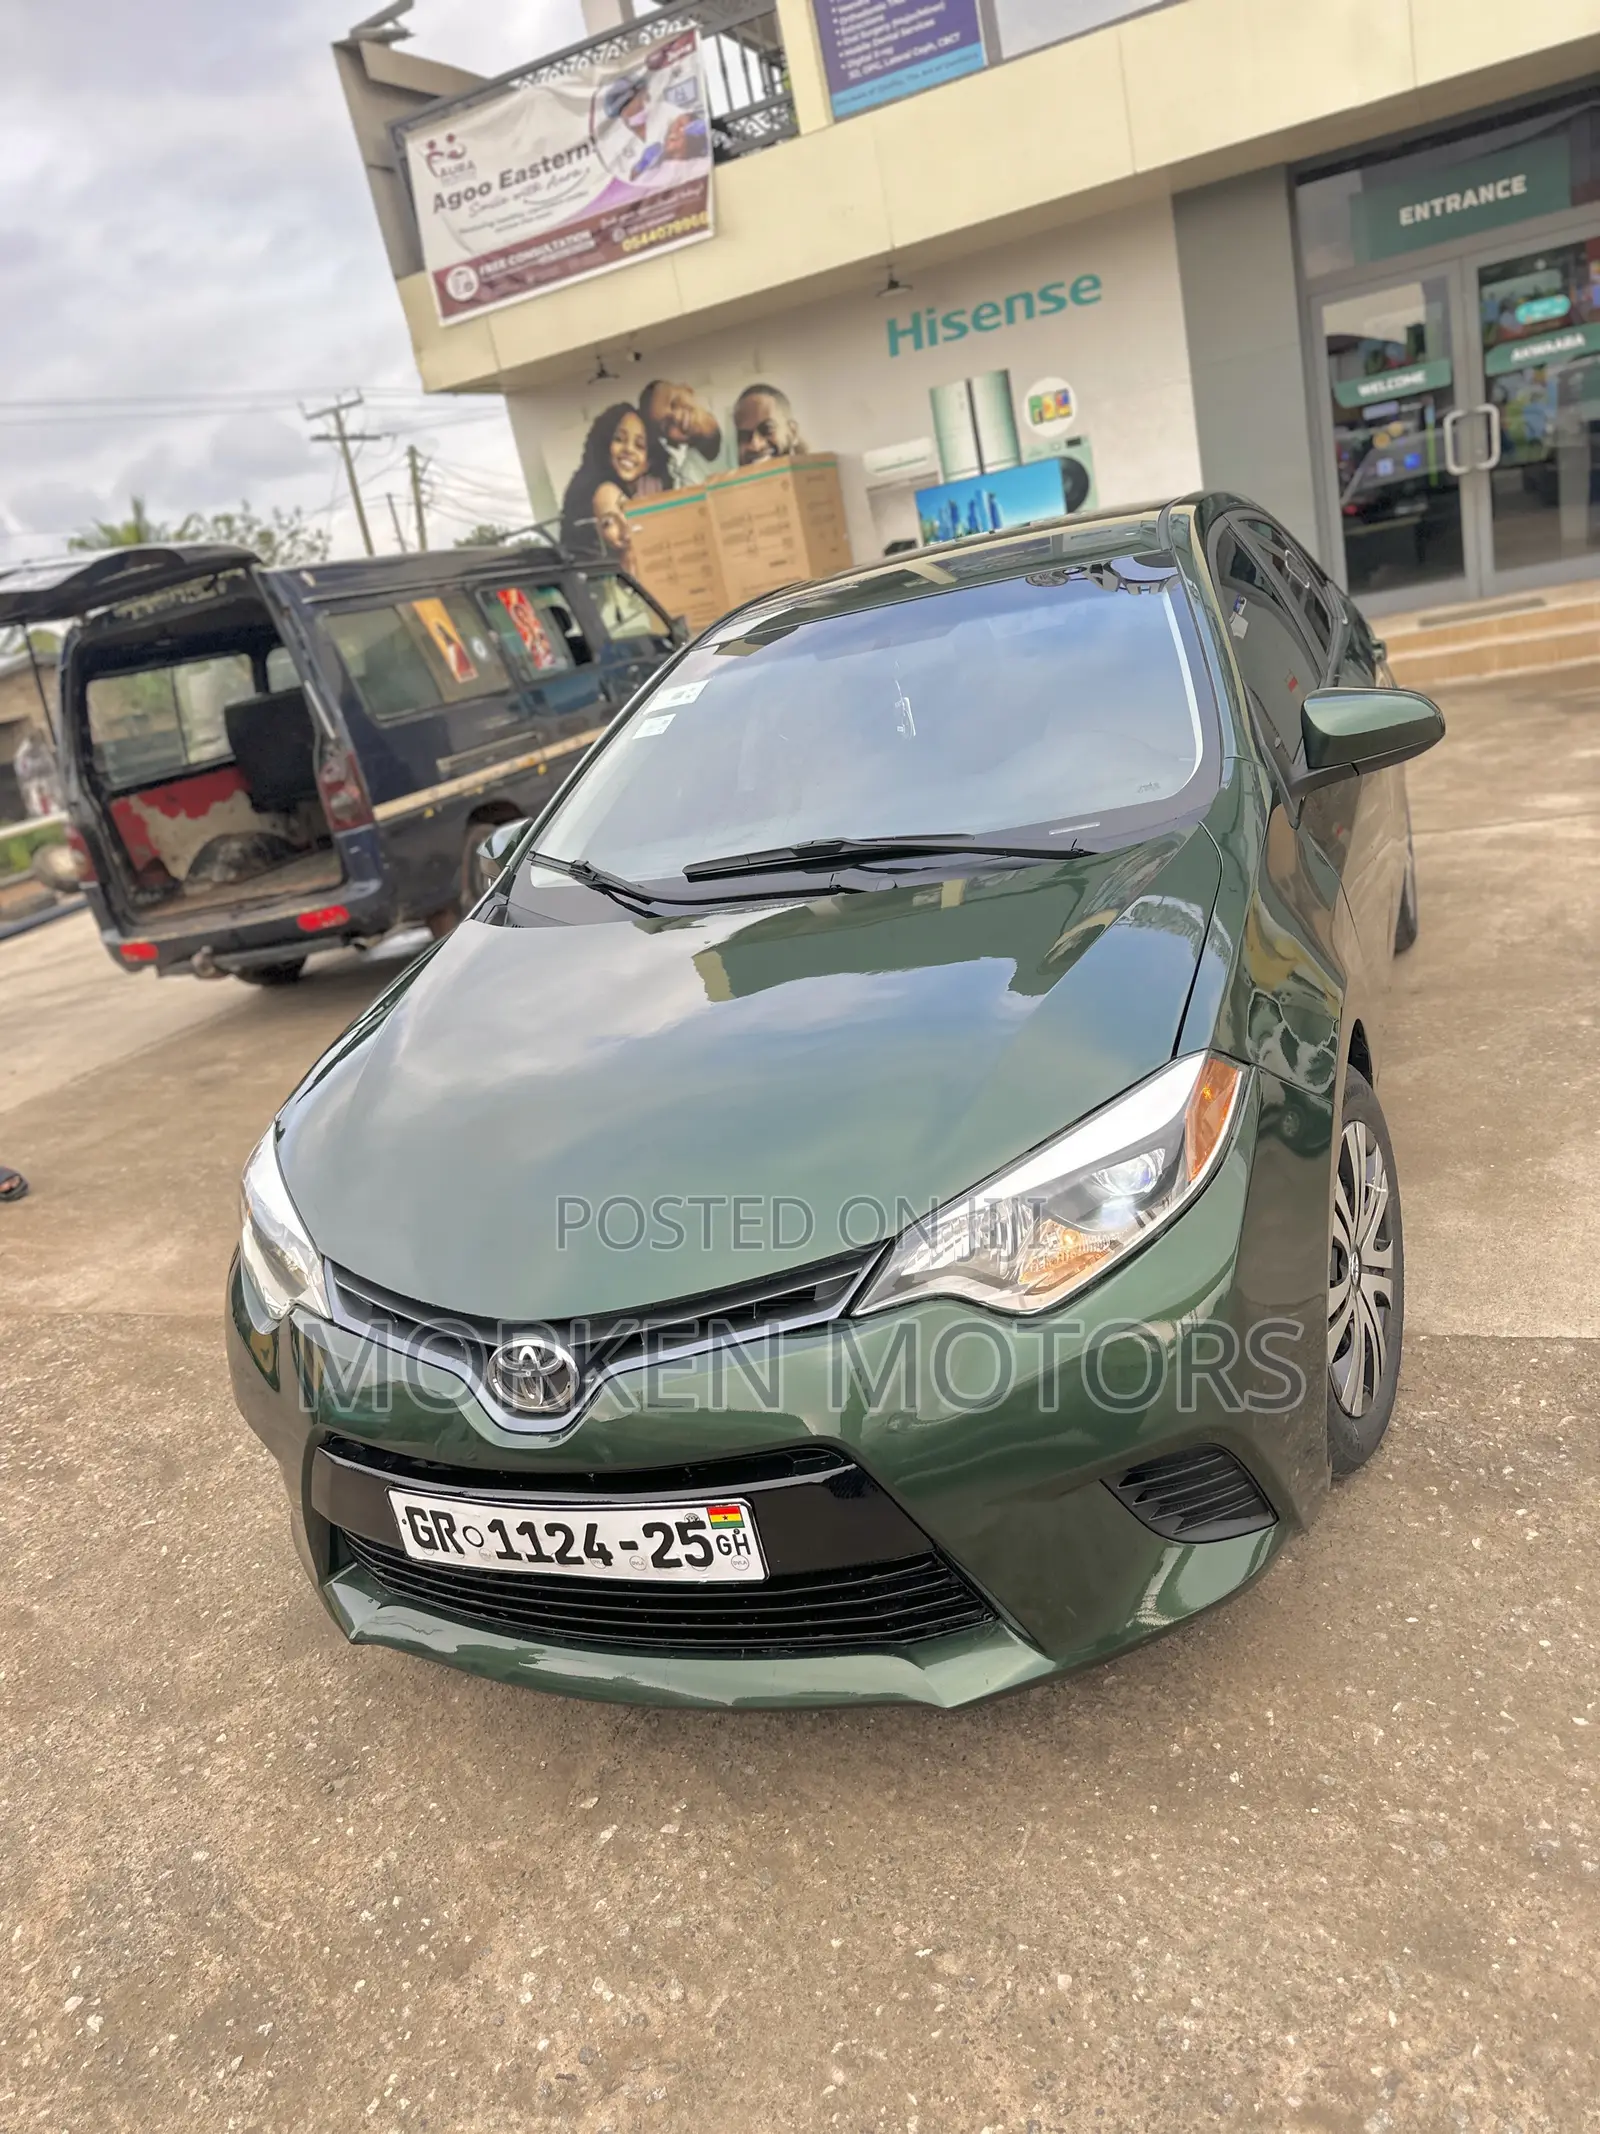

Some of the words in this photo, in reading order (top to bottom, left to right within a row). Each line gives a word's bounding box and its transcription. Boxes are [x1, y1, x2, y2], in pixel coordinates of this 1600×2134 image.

[433, 181, 493, 215] Agoo
[499, 135, 598, 190] Eastern!
[1399, 174, 1528, 227] ENTRANCE
[886, 273, 1103, 358] Hisense
[1358, 370, 1426, 397] WELCOME
[404, 1505, 466, 1556] GR
[487, 1518, 714, 1569] 1124-25
[715, 1533, 752, 1556] GH
